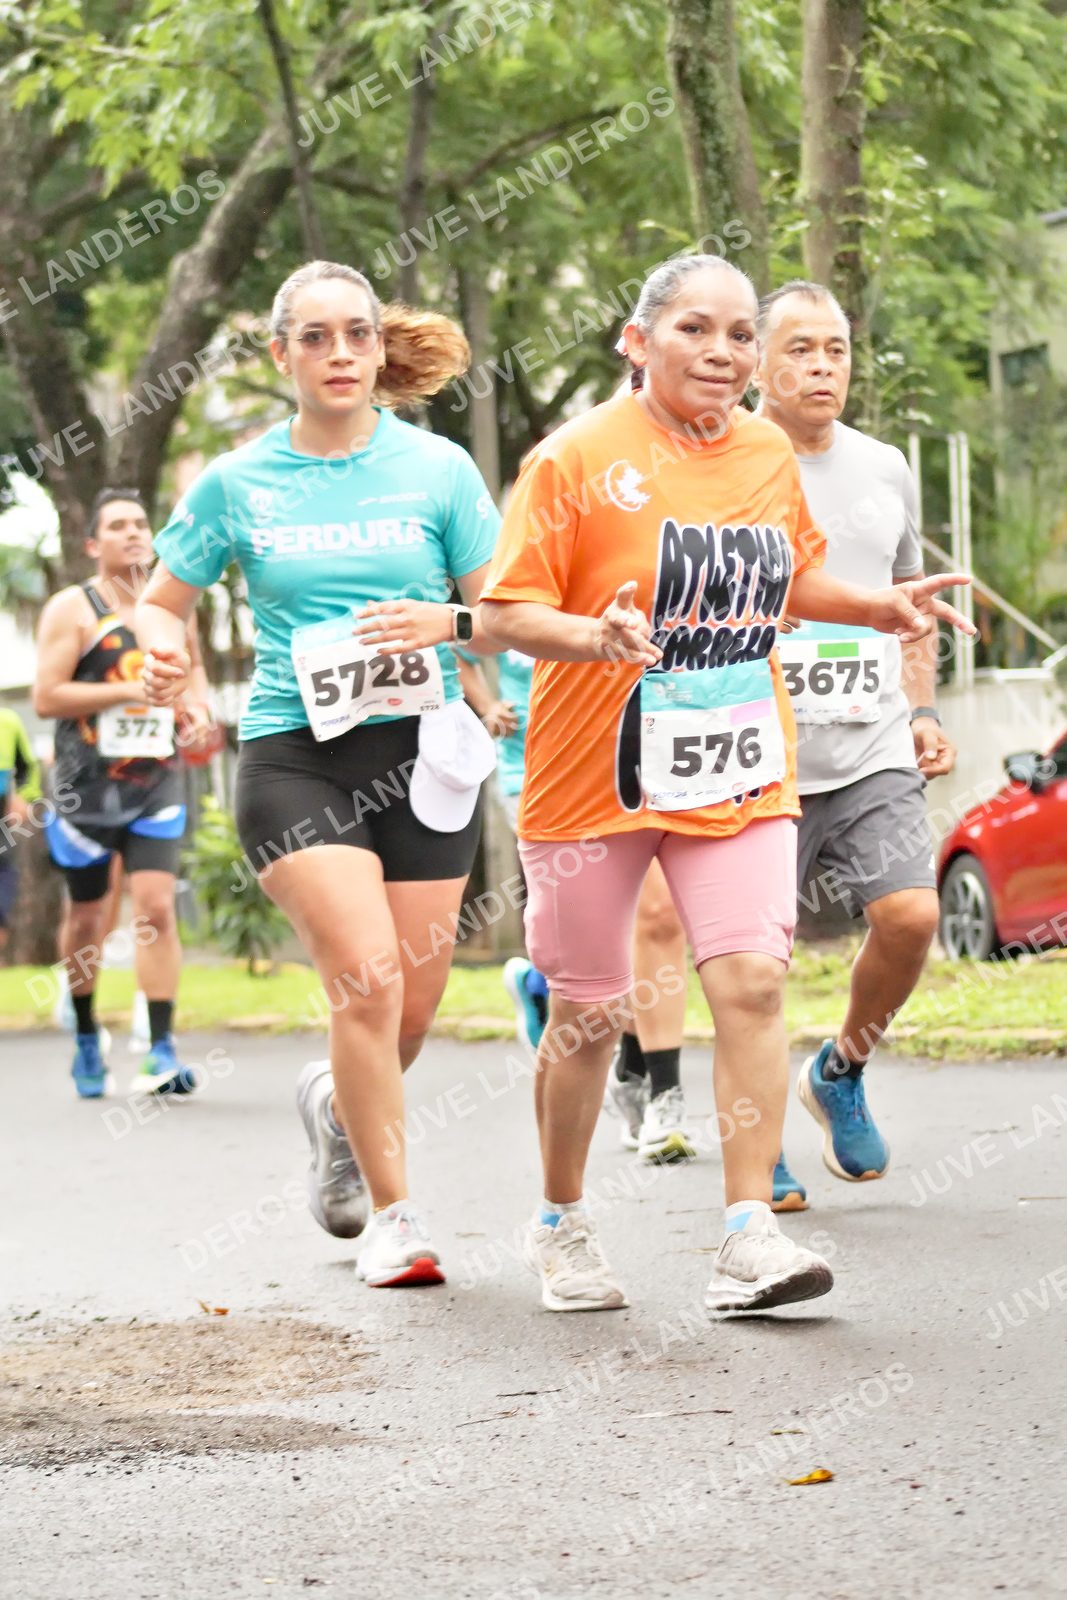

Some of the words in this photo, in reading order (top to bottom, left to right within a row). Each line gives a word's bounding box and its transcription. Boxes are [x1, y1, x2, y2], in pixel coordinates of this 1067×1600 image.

[251, 517, 426, 555] PERDURA
[310, 651, 430, 707] 5728
[781, 660, 880, 697] 3675
[116, 719, 160, 738] 372
[670, 727, 762, 778] 576
